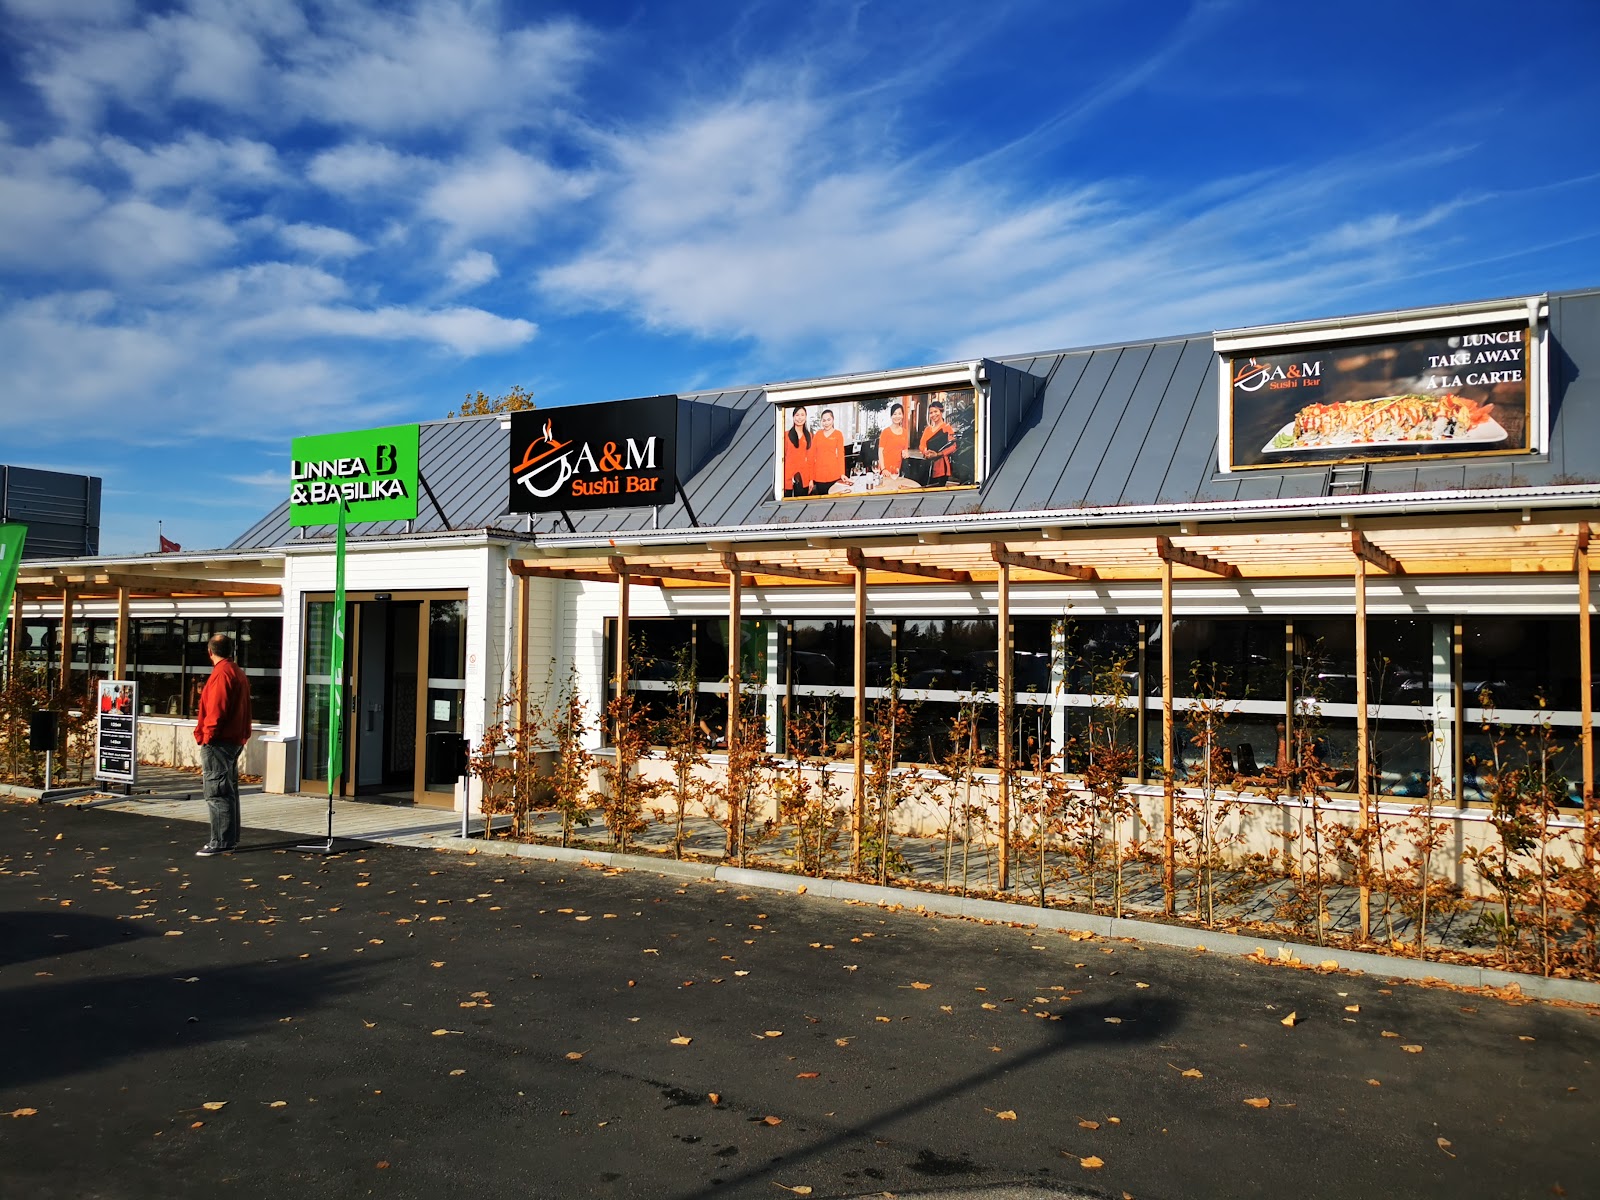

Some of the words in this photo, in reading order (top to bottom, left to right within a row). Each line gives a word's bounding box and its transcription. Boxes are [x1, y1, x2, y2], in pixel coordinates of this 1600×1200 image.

[1462, 330, 1522, 347] LUNCH
[1428, 352, 1472, 368] TAKE
[1474, 348, 1522, 364] AWAY
[1270, 361, 1321, 380] A&M
[1441, 374, 1463, 388] LA
[1465, 370, 1523, 385] CARTE
[1269, 380, 1298, 390] Sushi
[1303, 378, 1321, 387] Bar
[572, 436, 657, 474] A&M
[291, 457, 366, 480] LINNEA
[290, 483, 308, 504] &
[310, 479, 405, 505] BASILIKA
[571, 475, 620, 497] Sushi
[625, 475, 659, 493] Bar
